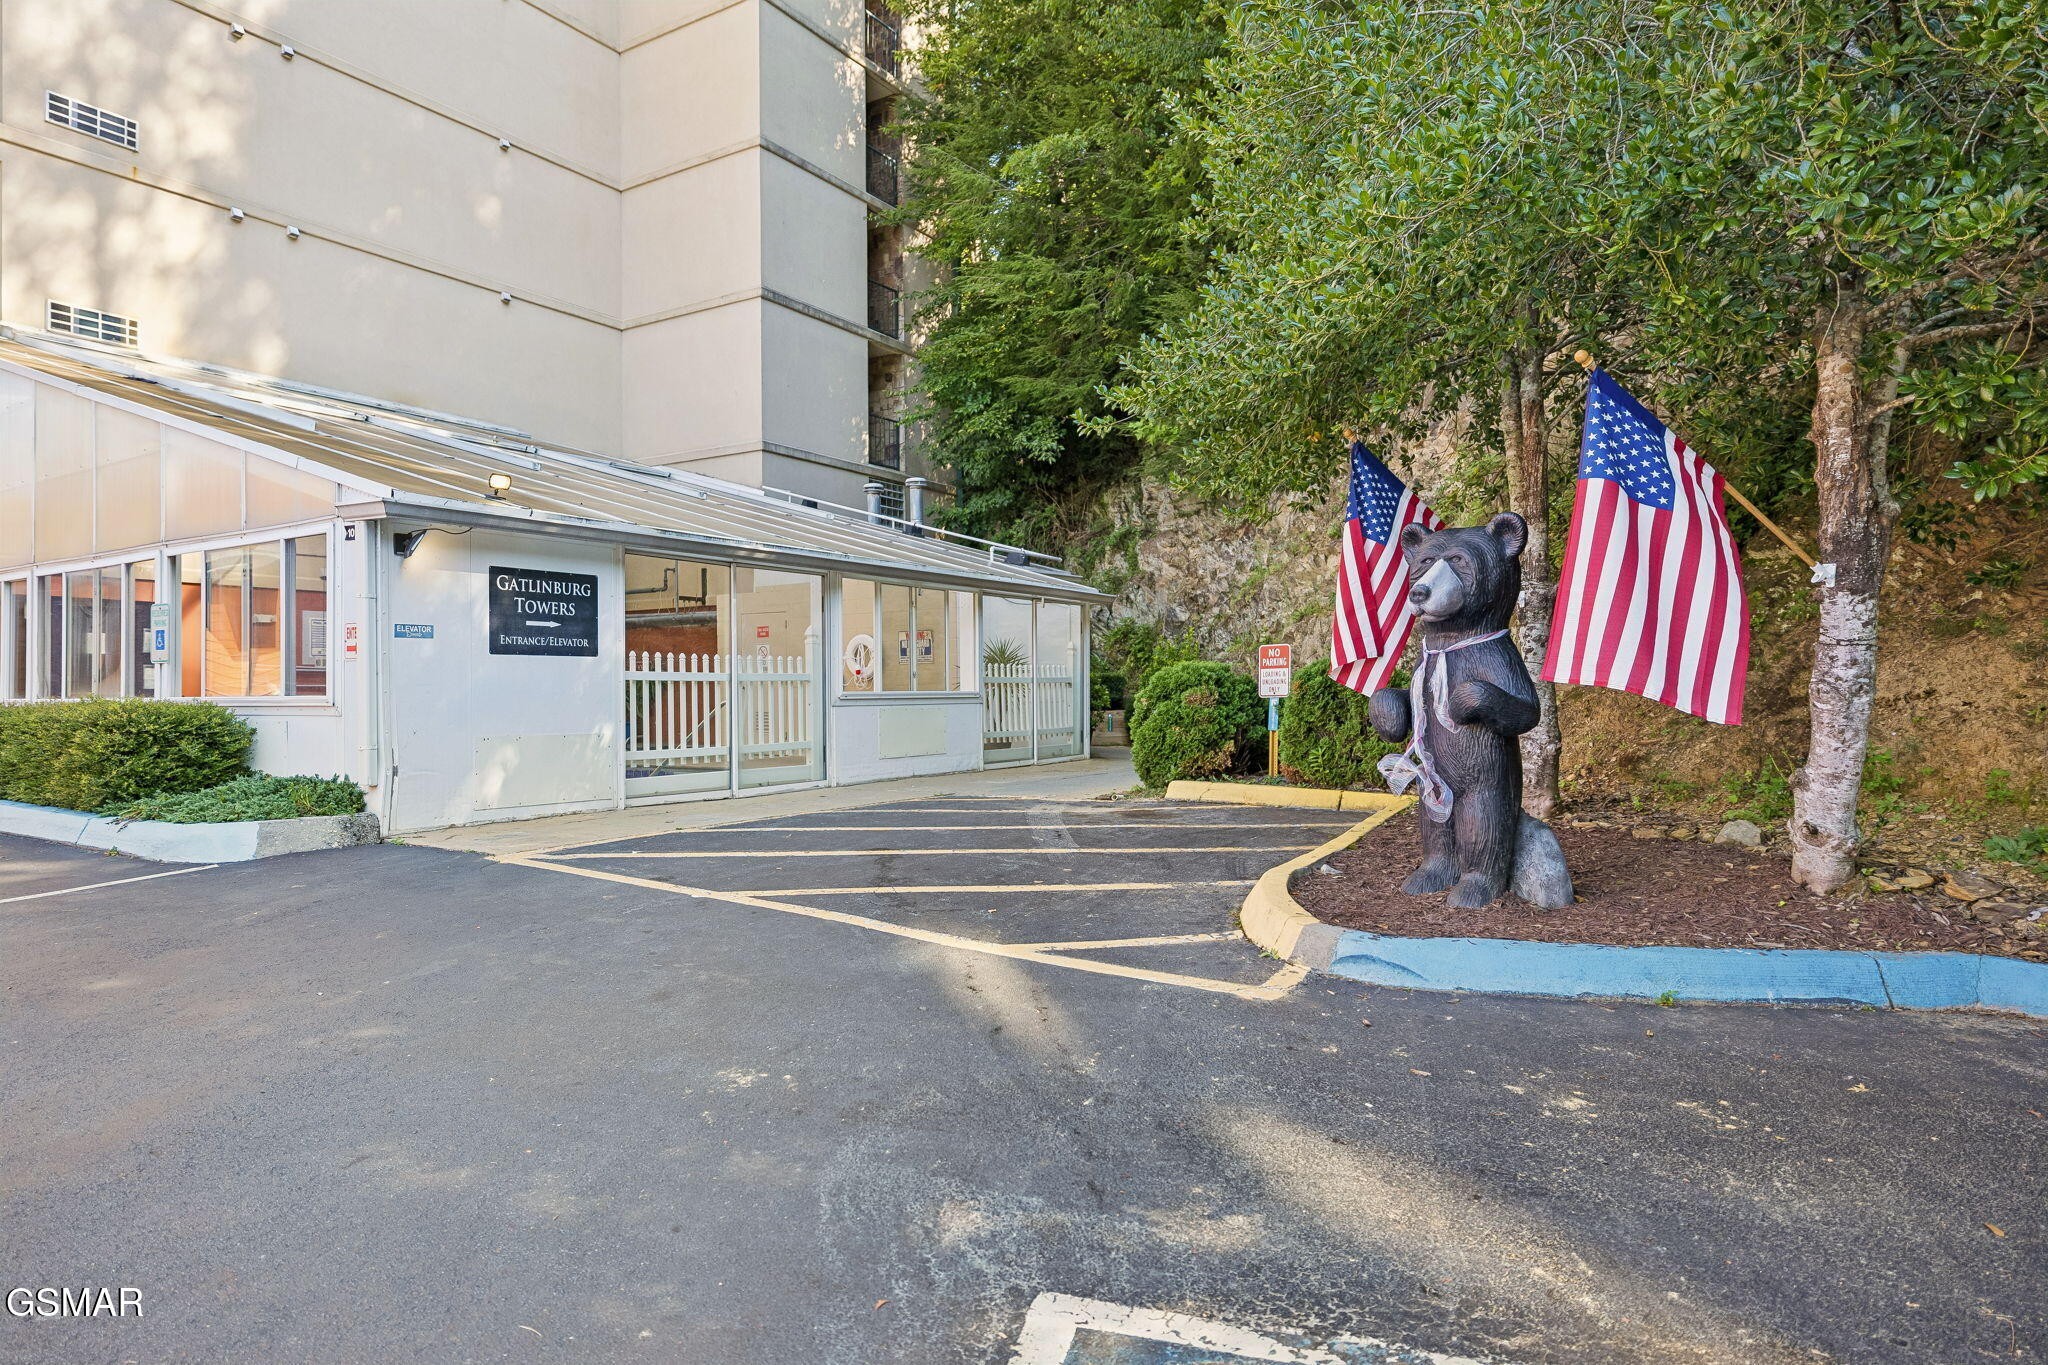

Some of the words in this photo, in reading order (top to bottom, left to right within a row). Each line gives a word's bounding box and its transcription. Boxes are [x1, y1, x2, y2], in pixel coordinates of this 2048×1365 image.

[496, 574, 591, 597] GATLINBURG
[513, 596, 576, 616] TOWERS
[396, 624, 432, 633] ELEVATOR
[500, 634, 589, 647] ENTRANCE/ELEVATOR
[1268, 648, 1280, 657] NO
[1262, 657, 1287, 667] PARKING
